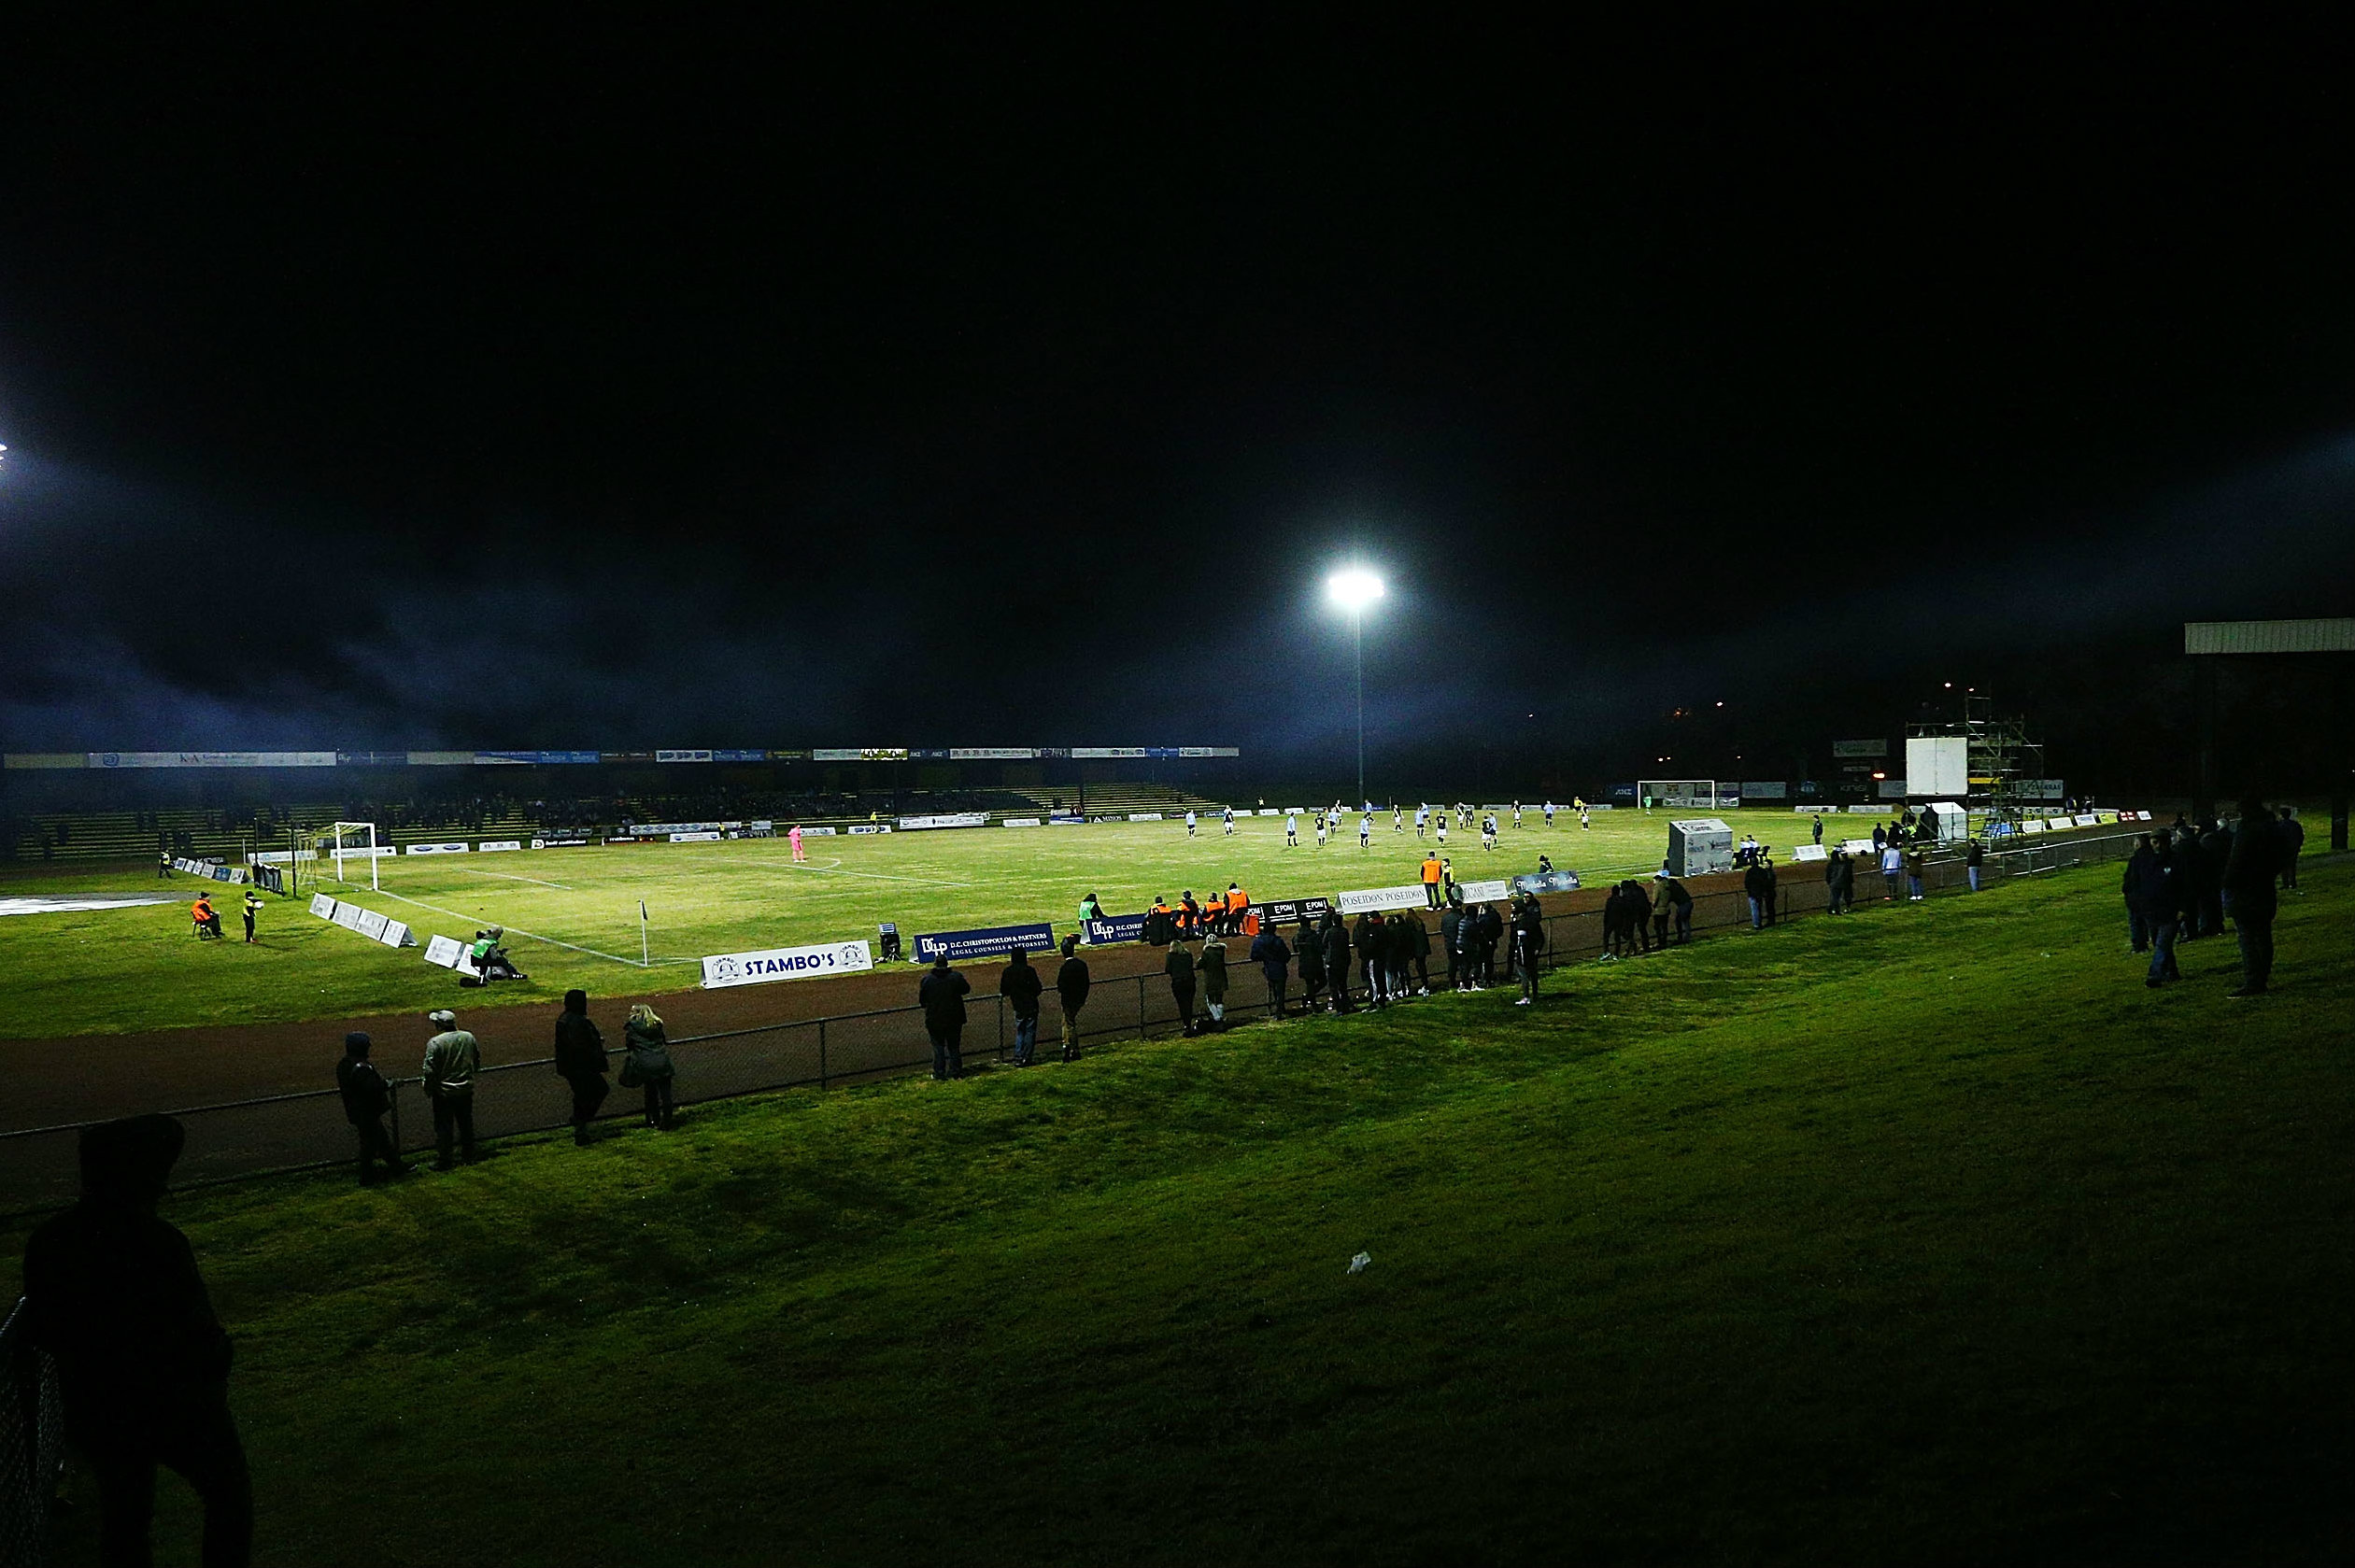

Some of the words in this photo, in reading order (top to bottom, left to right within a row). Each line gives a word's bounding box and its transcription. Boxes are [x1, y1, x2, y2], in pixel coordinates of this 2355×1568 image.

[1341, 894, 1383, 906] POSEIDON
[1385, 889, 1426, 901] POSEIDON
[1273, 903, 1293, 914] EPDM
[1018, 933, 1046, 941] PARTNERS
[973, 945, 1006, 954] COUNSELS
[745, 953, 836, 976] STAMBO'S
